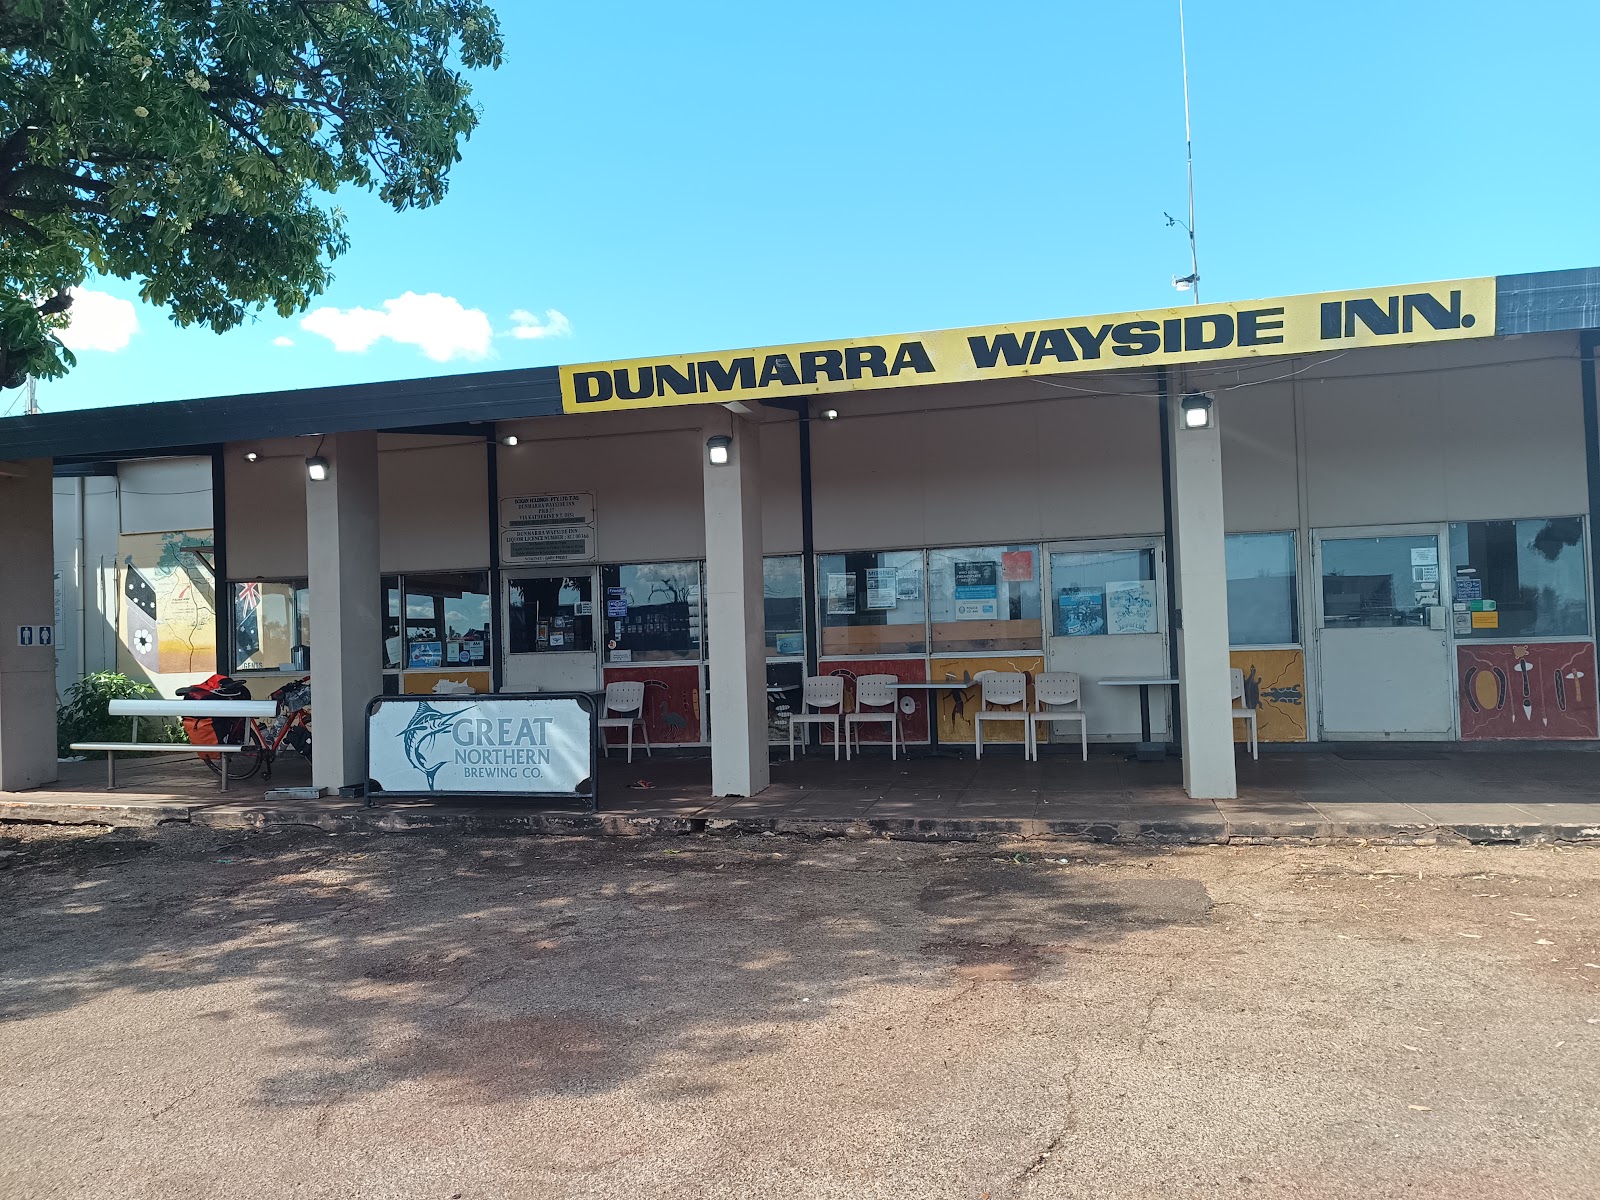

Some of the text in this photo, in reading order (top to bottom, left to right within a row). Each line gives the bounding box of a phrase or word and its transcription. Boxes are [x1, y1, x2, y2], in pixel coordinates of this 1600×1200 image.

[573, 290, 1476, 403] DUNMARRA WAYSIDE INN.
[452, 717, 553, 746] GREAT
[454, 748, 551, 765] NORTHERN
[464, 767, 543, 779] BREWING CO.
